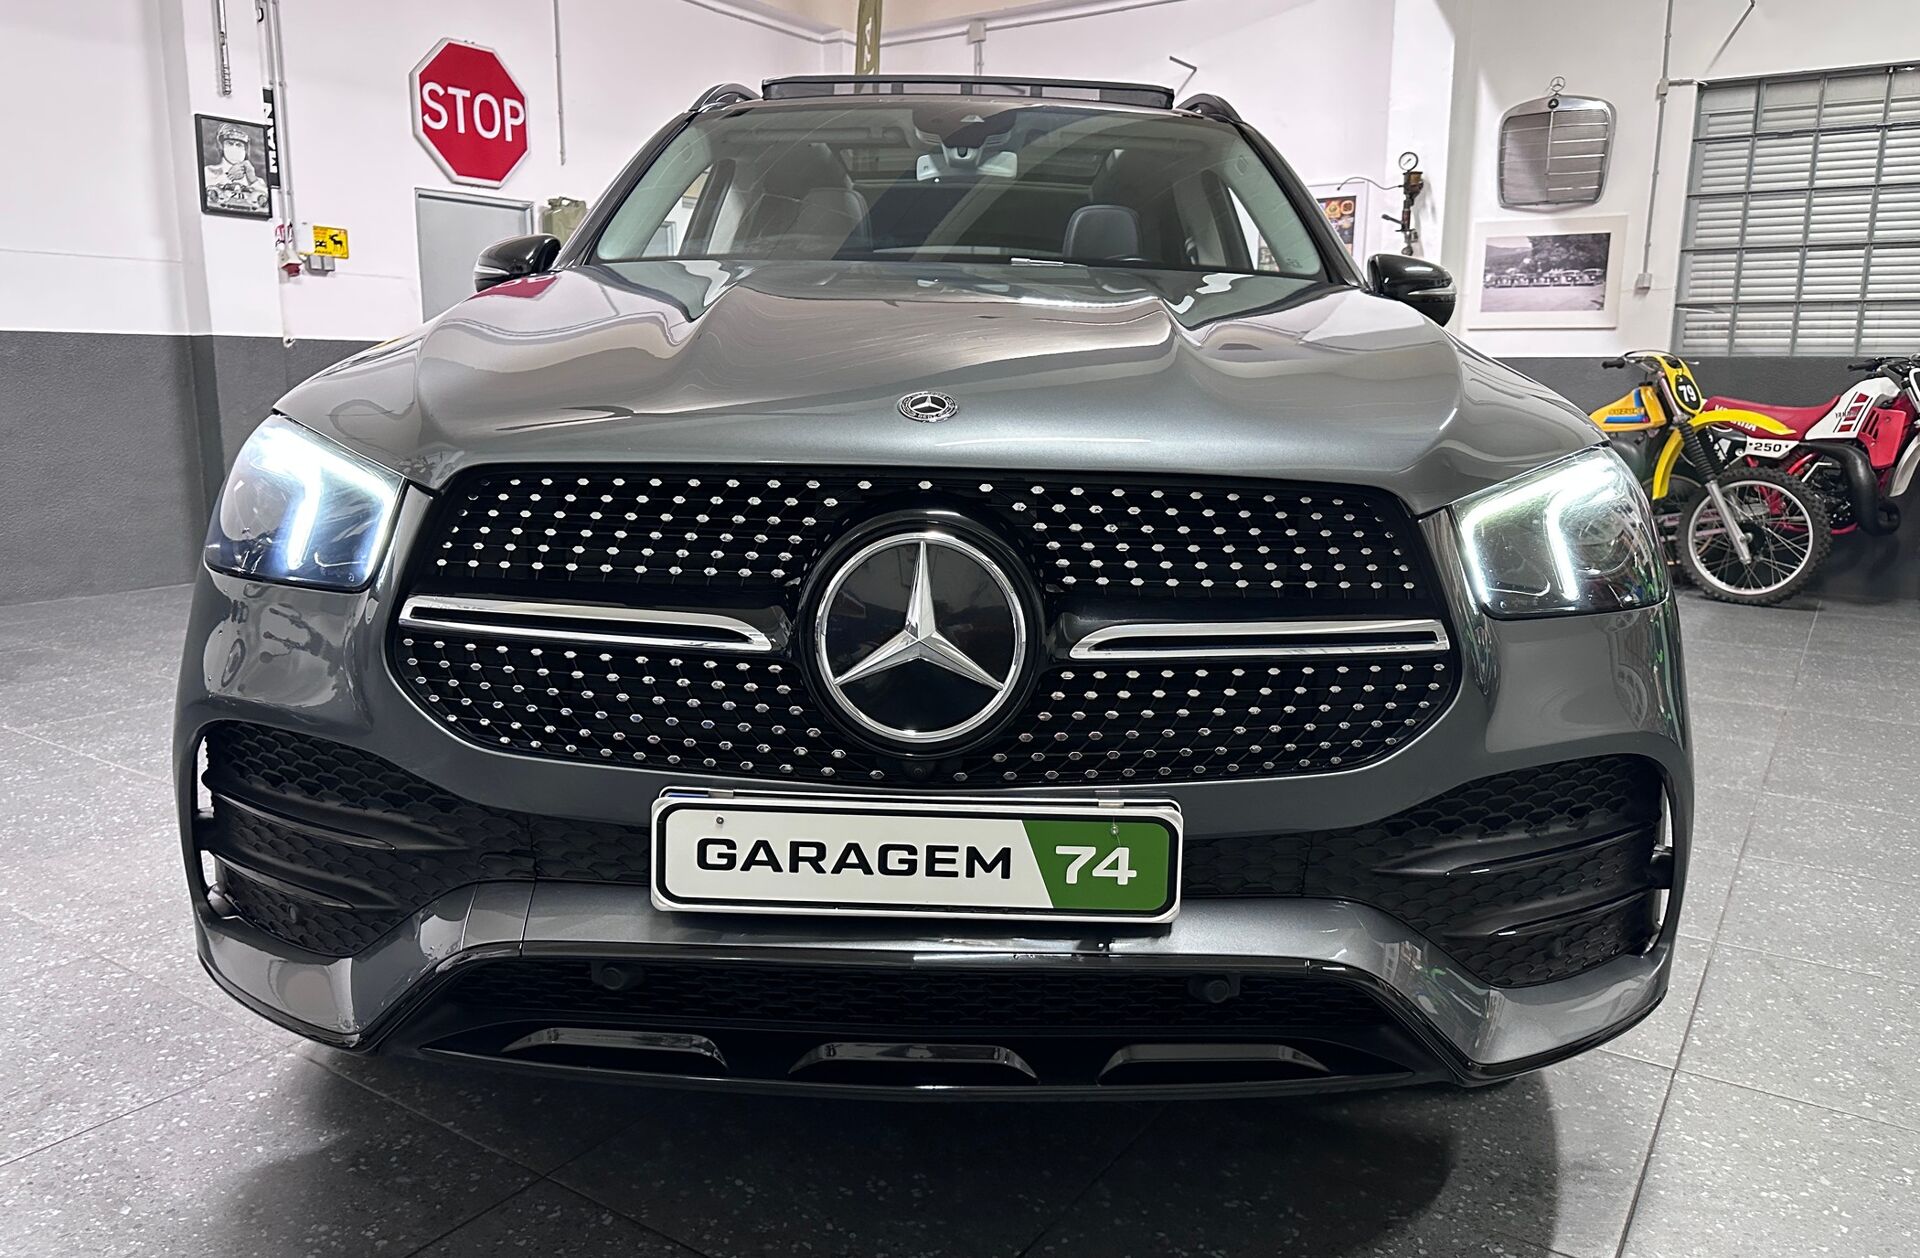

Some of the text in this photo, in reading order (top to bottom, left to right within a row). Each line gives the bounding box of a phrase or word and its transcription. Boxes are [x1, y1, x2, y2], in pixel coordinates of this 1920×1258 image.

[422, 82, 525, 142] STOP
[1678, 384, 1697, 402] 79
[1753, 442, 1782, 452] 250
[697, 837, 1138, 886] GARAGEM 74
